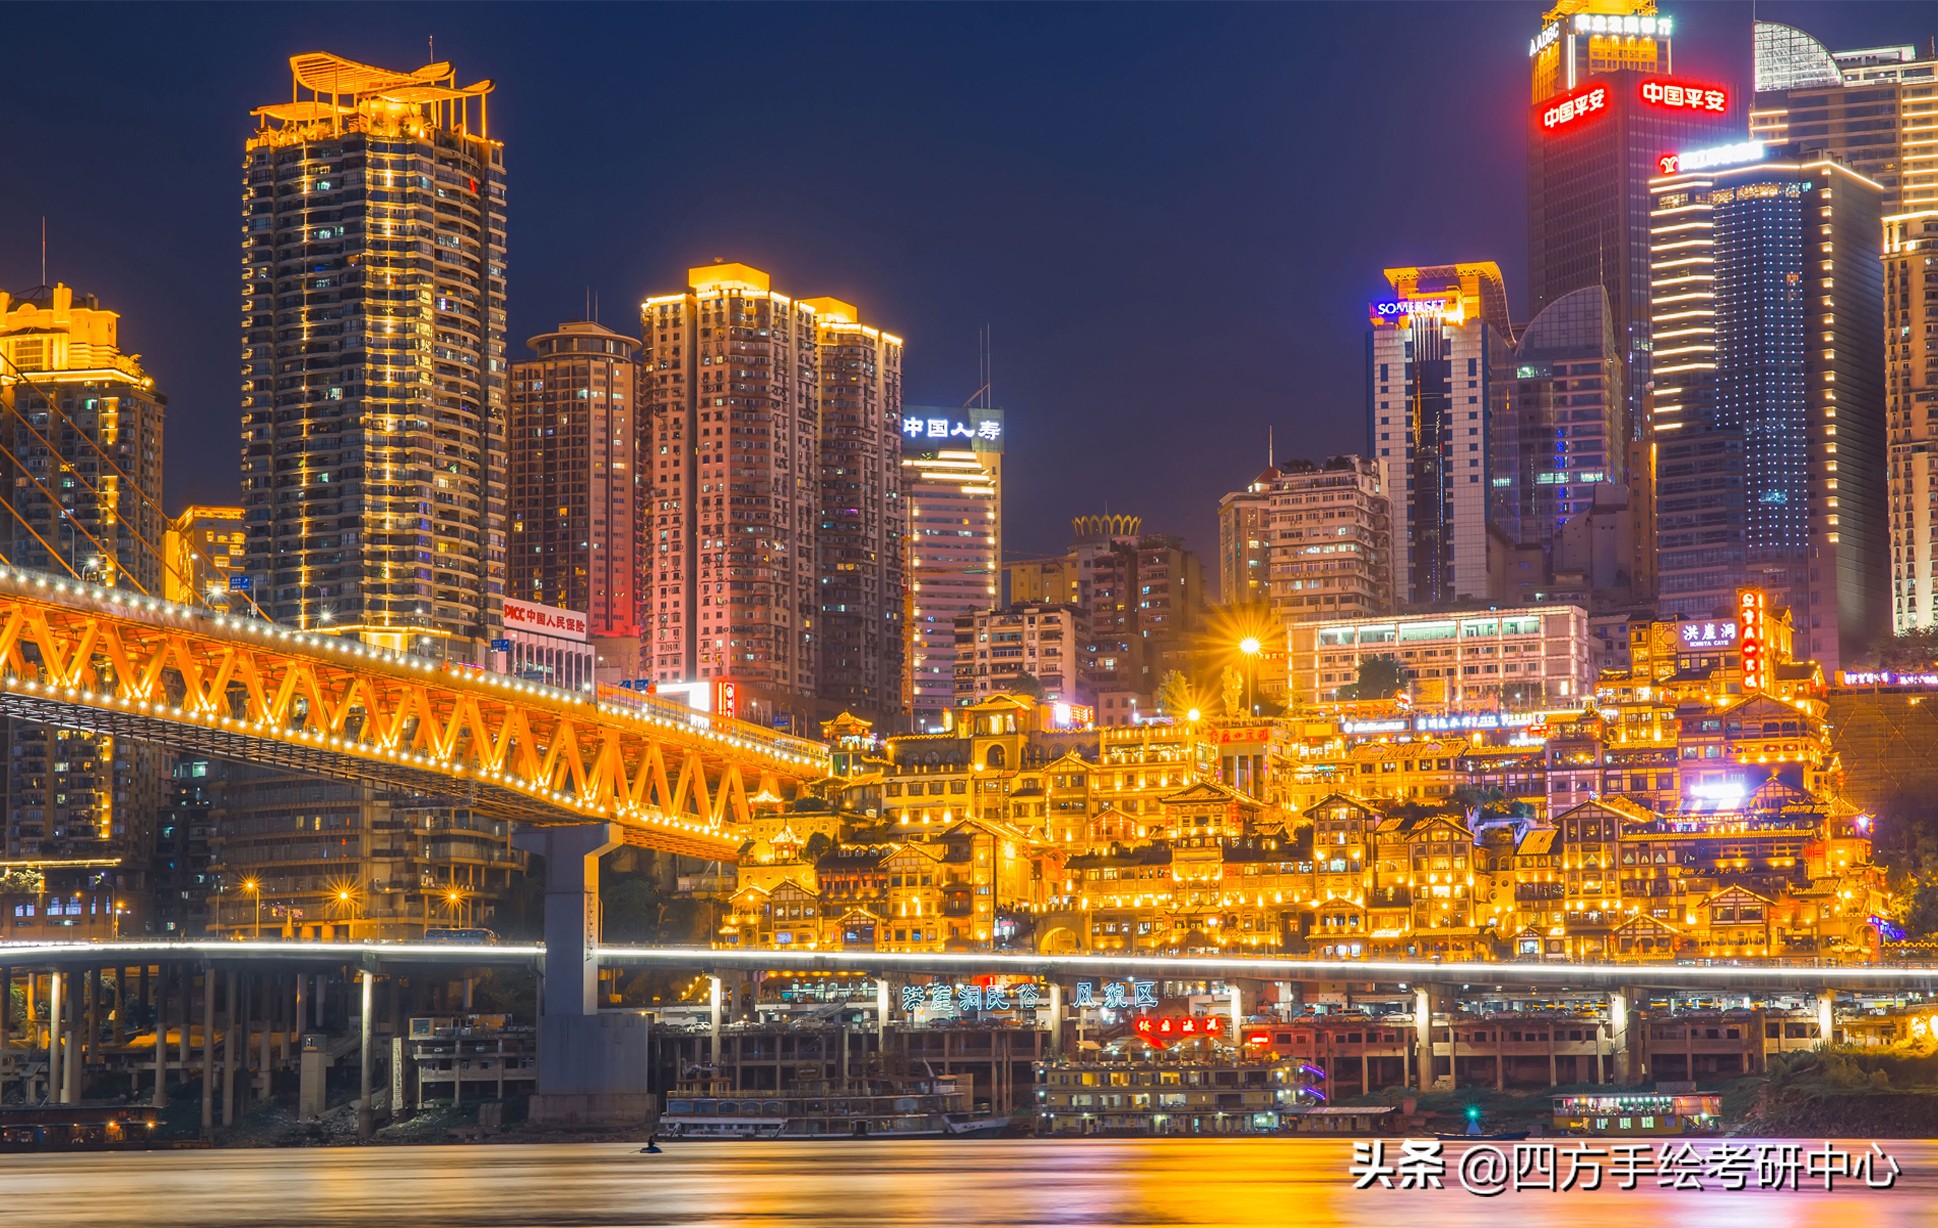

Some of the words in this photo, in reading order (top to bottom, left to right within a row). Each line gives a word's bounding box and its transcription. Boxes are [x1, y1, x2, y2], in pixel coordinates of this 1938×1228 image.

[1544, 88, 1605, 128] 中国平安
[1643, 82, 1725, 112] 中国平安
[1378, 299, 1446, 315] SOMERSET
[903, 416, 1001, 440] 中国人寿
[504, 604, 525, 622] PICC
[526, 609, 585, 633] 中国人民保险
[1683, 622, 1736, 640] 洪崖洞
[1073, 981, 1158, 1008] 风貌区
